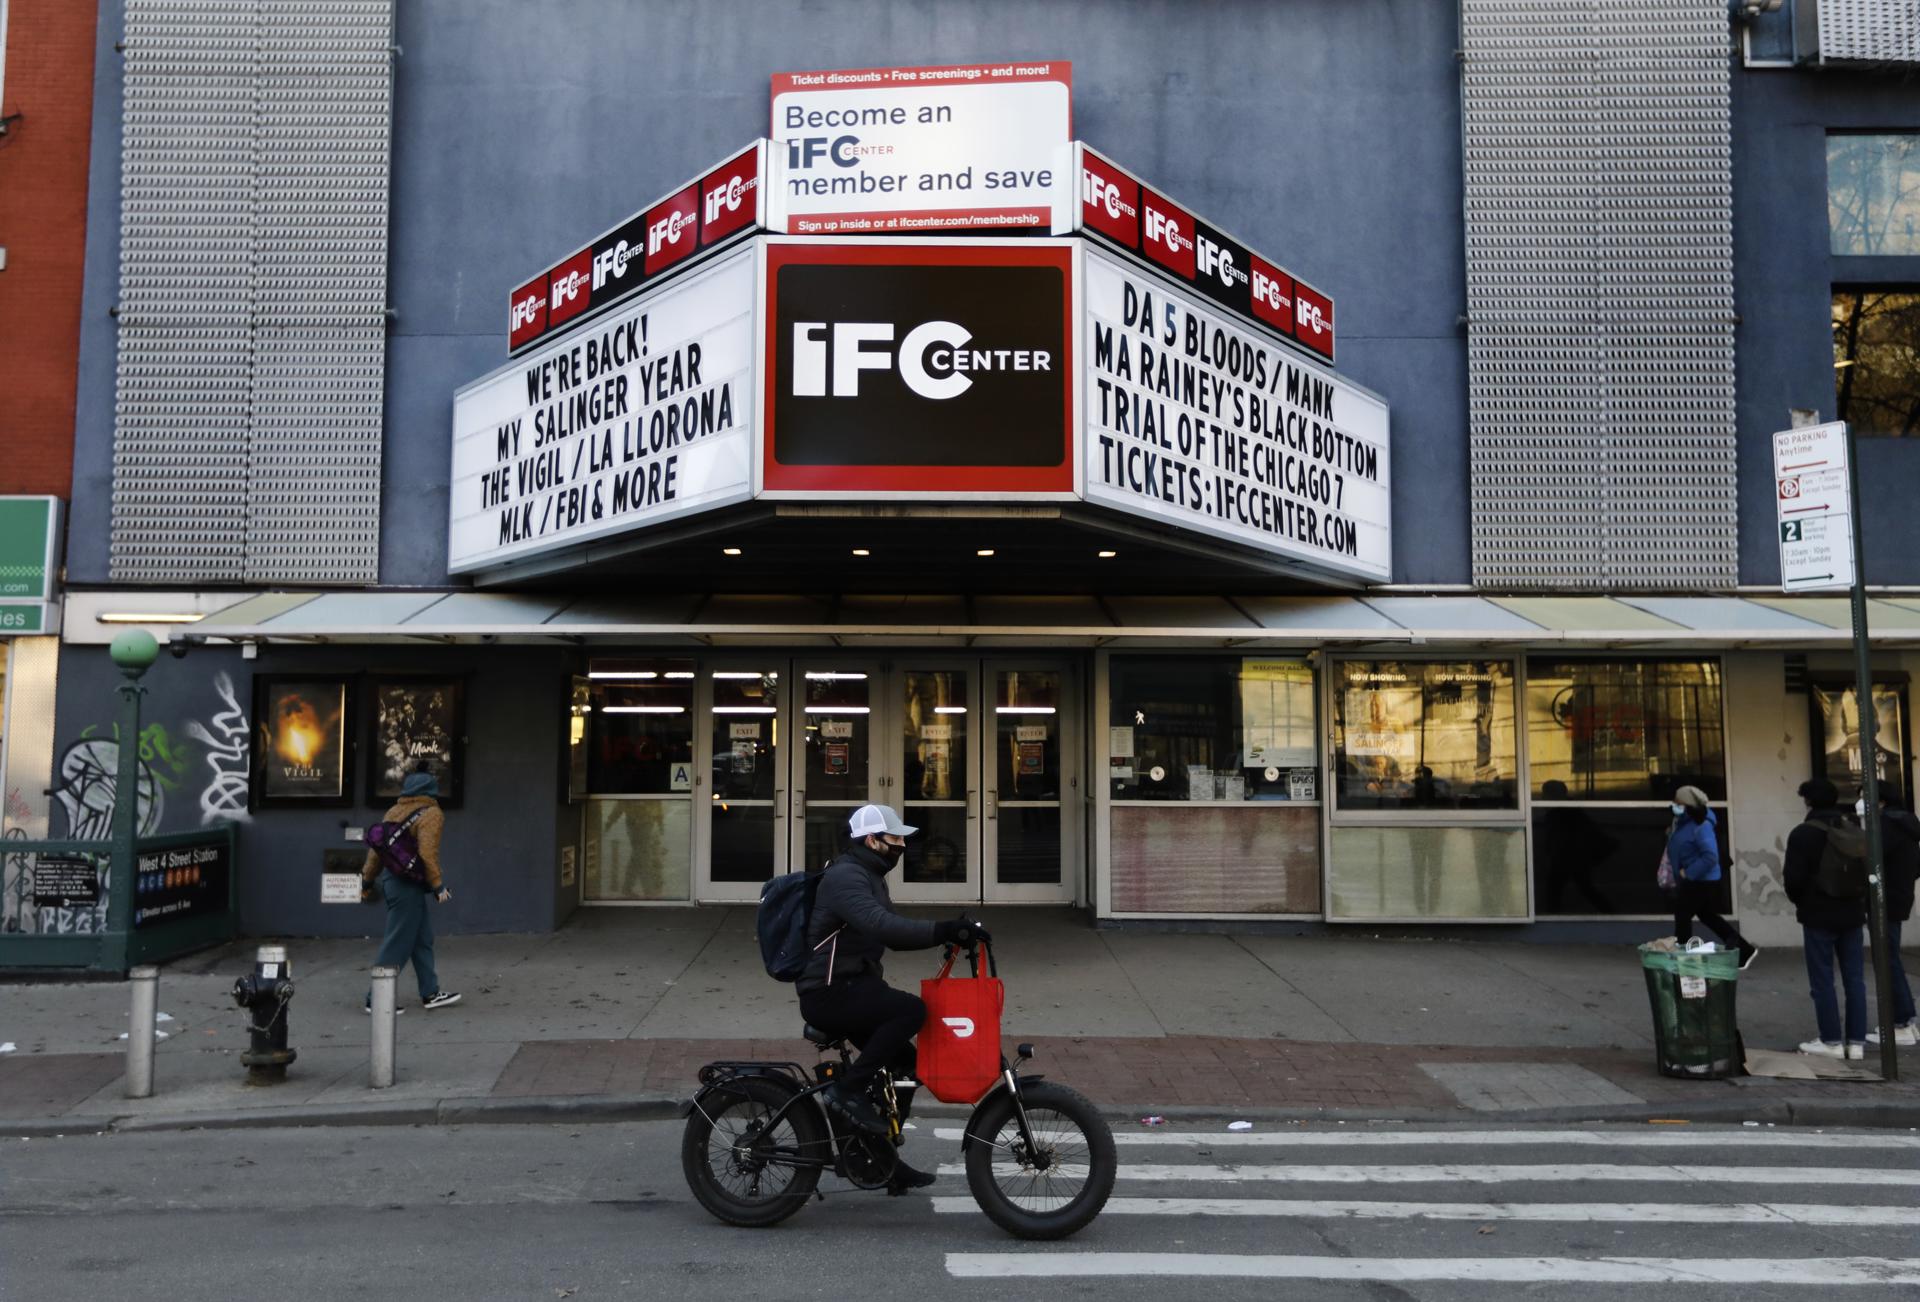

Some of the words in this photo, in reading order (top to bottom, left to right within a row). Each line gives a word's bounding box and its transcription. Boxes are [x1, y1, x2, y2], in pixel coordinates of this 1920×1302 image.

[791, 74, 825, 85] Ticket
[827, 72, 881, 83] discounts
[891, 70, 917, 80] Free
[920, 68, 981, 80] screenings
[991, 66, 1013, 76] and
[1016, 64, 1050, 75] more!
[786, 106, 906, 129] Become
[917, 105, 952, 123] an
[844, 145, 894, 156] CENTER
[788, 170, 908, 196] member
[918, 166, 972, 191] and
[984, 168, 1052, 189] save
[1111, 197, 1136, 218] CENTER
[672, 212, 696, 232] CENTER
[798, 221, 822, 231] Sign
[824, 222, 838, 231] up
[840, 219, 871, 228] inside
[873, 220, 885, 228] or
[887, 219, 898, 227] at
[900, 214, 1040, 227] ifccenter.com/membership
[1170, 231, 1193, 251] CENTER
[618, 243, 644, 264] CENTER
[570, 273, 590, 290] CENTER
[1224, 262, 1249, 285] CENTER
[1272, 290, 1291, 308] CENTER
[527, 347, 582, 406] WE'RE
[587, 314, 648, 381] BACK!
[931, 350, 1051, 371] CENTER
[1123, 280, 1155, 340] DA
[1163, 302, 1177, 347] 5
[1185, 312, 1268, 394] BLOODS
[1286, 364, 1334, 422] MANK
[497, 418, 522, 463] MY
[534, 374, 628, 448] SALINGER
[640, 342, 702, 406] YEAR
[1095, 320, 1132, 382] MA
[1140, 341, 1245, 428] RAINEY'S
[1250, 393, 1308, 456] BLACK
[1312, 422, 1378, 482] BOTTOM
[481, 466, 510, 510] THE
[518, 447, 564, 497] VIGIL
[589, 429, 614, 474] LA
[623, 382, 734, 464] LLORONA
[1097, 378, 1172, 450] TRIAL
[1177, 412, 1206, 460] OF
[1210, 424, 1250, 478] THE
[1253, 442, 1331, 506] CHICAGO
[1334, 474, 1344, 510] 7
[1778, 437, 1790, 446] NO
[1792, 430, 1828, 444] PARKING
[1779, 445, 1812, 457] Anytime
[499, 500, 533, 546] MLK
[556, 484, 588, 530] FBI
[591, 478, 603, 520] &
[612, 455, 678, 516] MORE
[1785, 522, 1798, 542] 2
[0, 582, 29, 592] .com
[410, 740, 438, 758] Mank
[283, 767, 323, 777] VIGIL
[674, 766, 690, 782] A
[139, 856, 158, 872] West
[160, 853, 167, 868] 4
[169, 852, 191, 868] Street
[193, 848, 218, 863] Station
